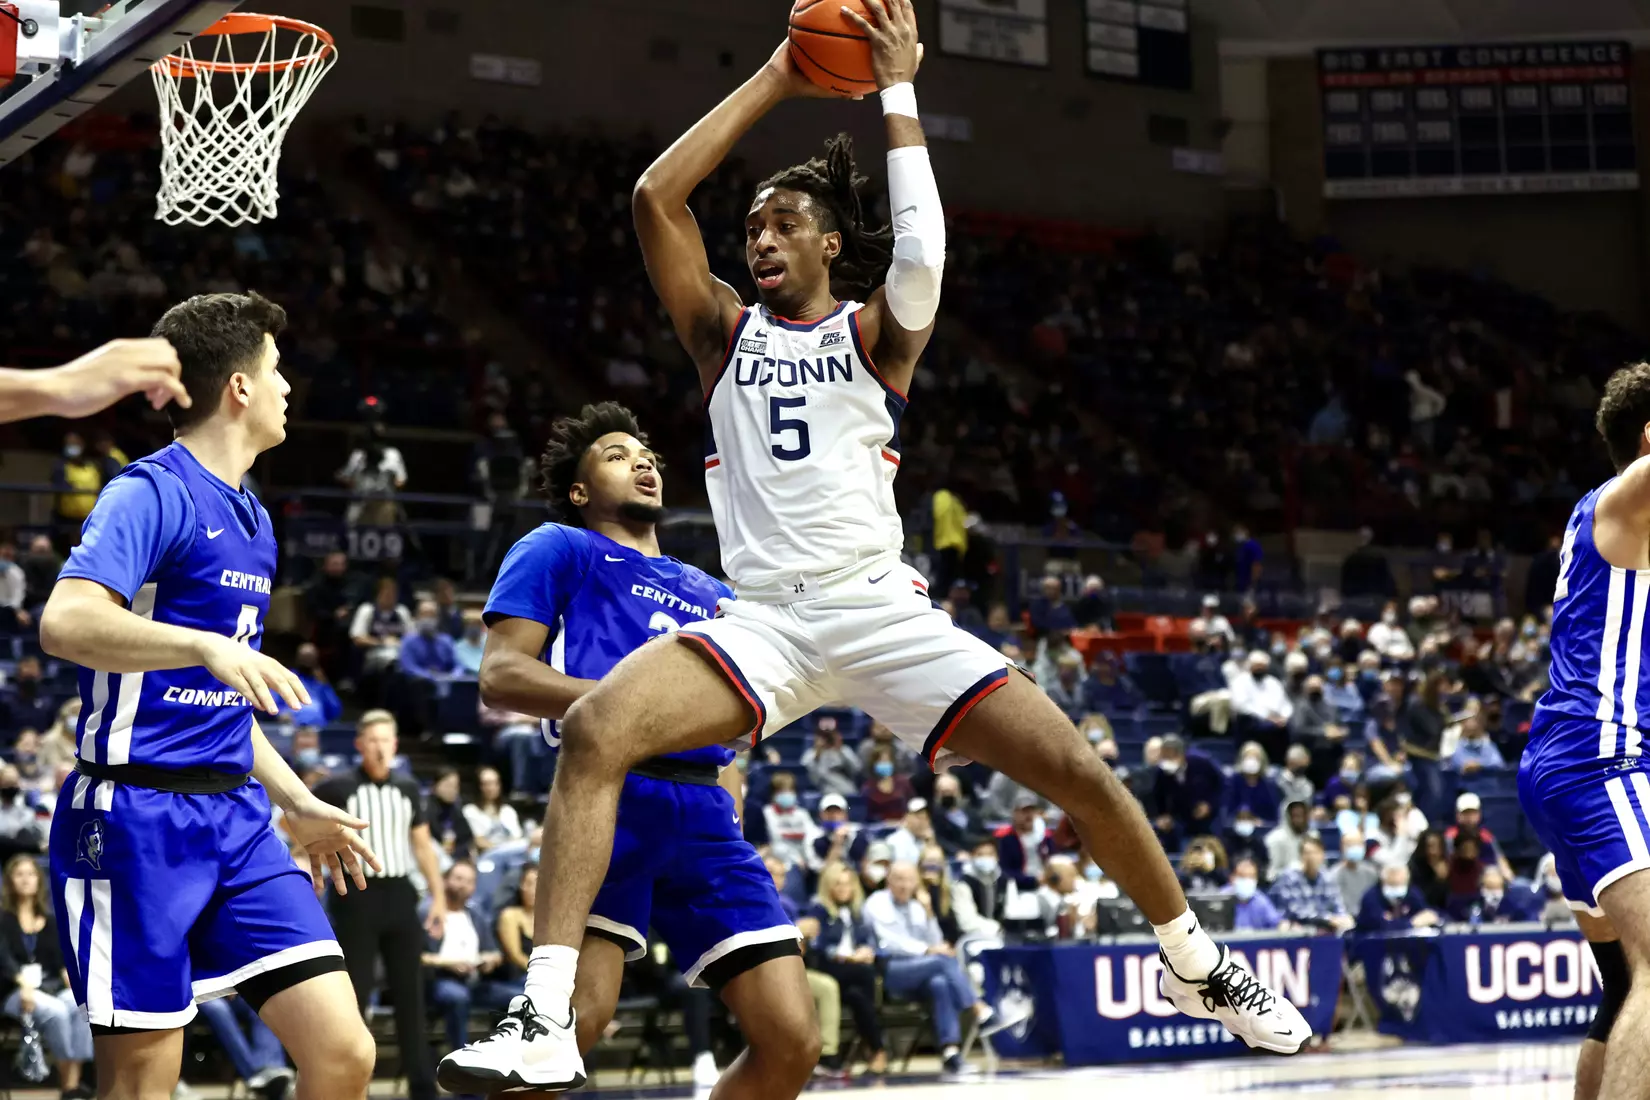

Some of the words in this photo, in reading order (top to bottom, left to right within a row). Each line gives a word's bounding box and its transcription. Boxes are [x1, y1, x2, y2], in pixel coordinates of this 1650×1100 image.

[820, 336, 846, 346] EAST
[822, 331, 841, 340] BIG
[735, 354, 853, 387] UCONN
[769, 396, 811, 461] 5
[220, 569, 272, 595] CENTRAL
[631, 584, 711, 620] CENTRAL
